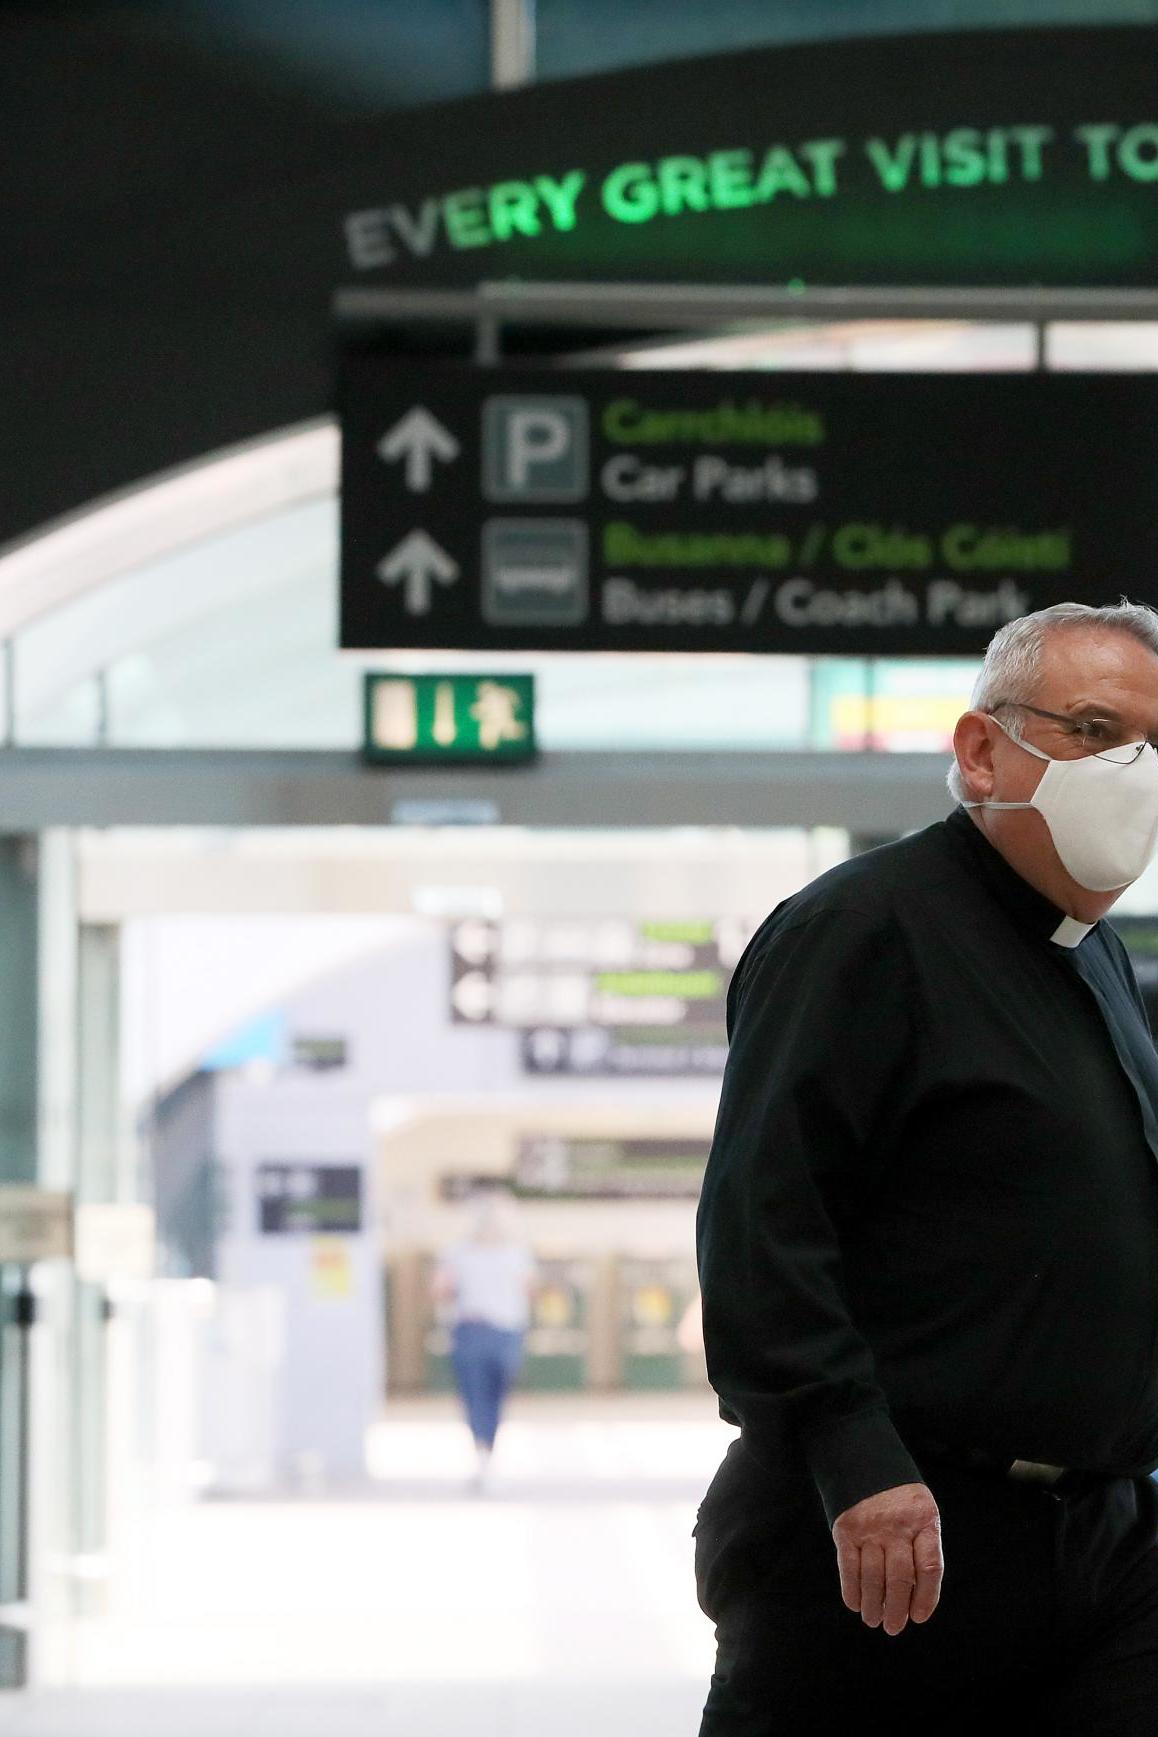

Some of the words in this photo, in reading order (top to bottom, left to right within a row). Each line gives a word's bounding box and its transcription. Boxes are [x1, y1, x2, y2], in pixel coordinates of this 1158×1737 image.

[344, 171, 585, 269] EVERY
[602, 141, 844, 224] GREAT
[866, 127, 1053, 192] VISIT
[602, 455, 683, 501] Car
[694, 456, 817, 502] Parks
[603, 578, 734, 624] Buses
[775, 579, 917, 626] Coach
[928, 580, 1025, 627] Park
